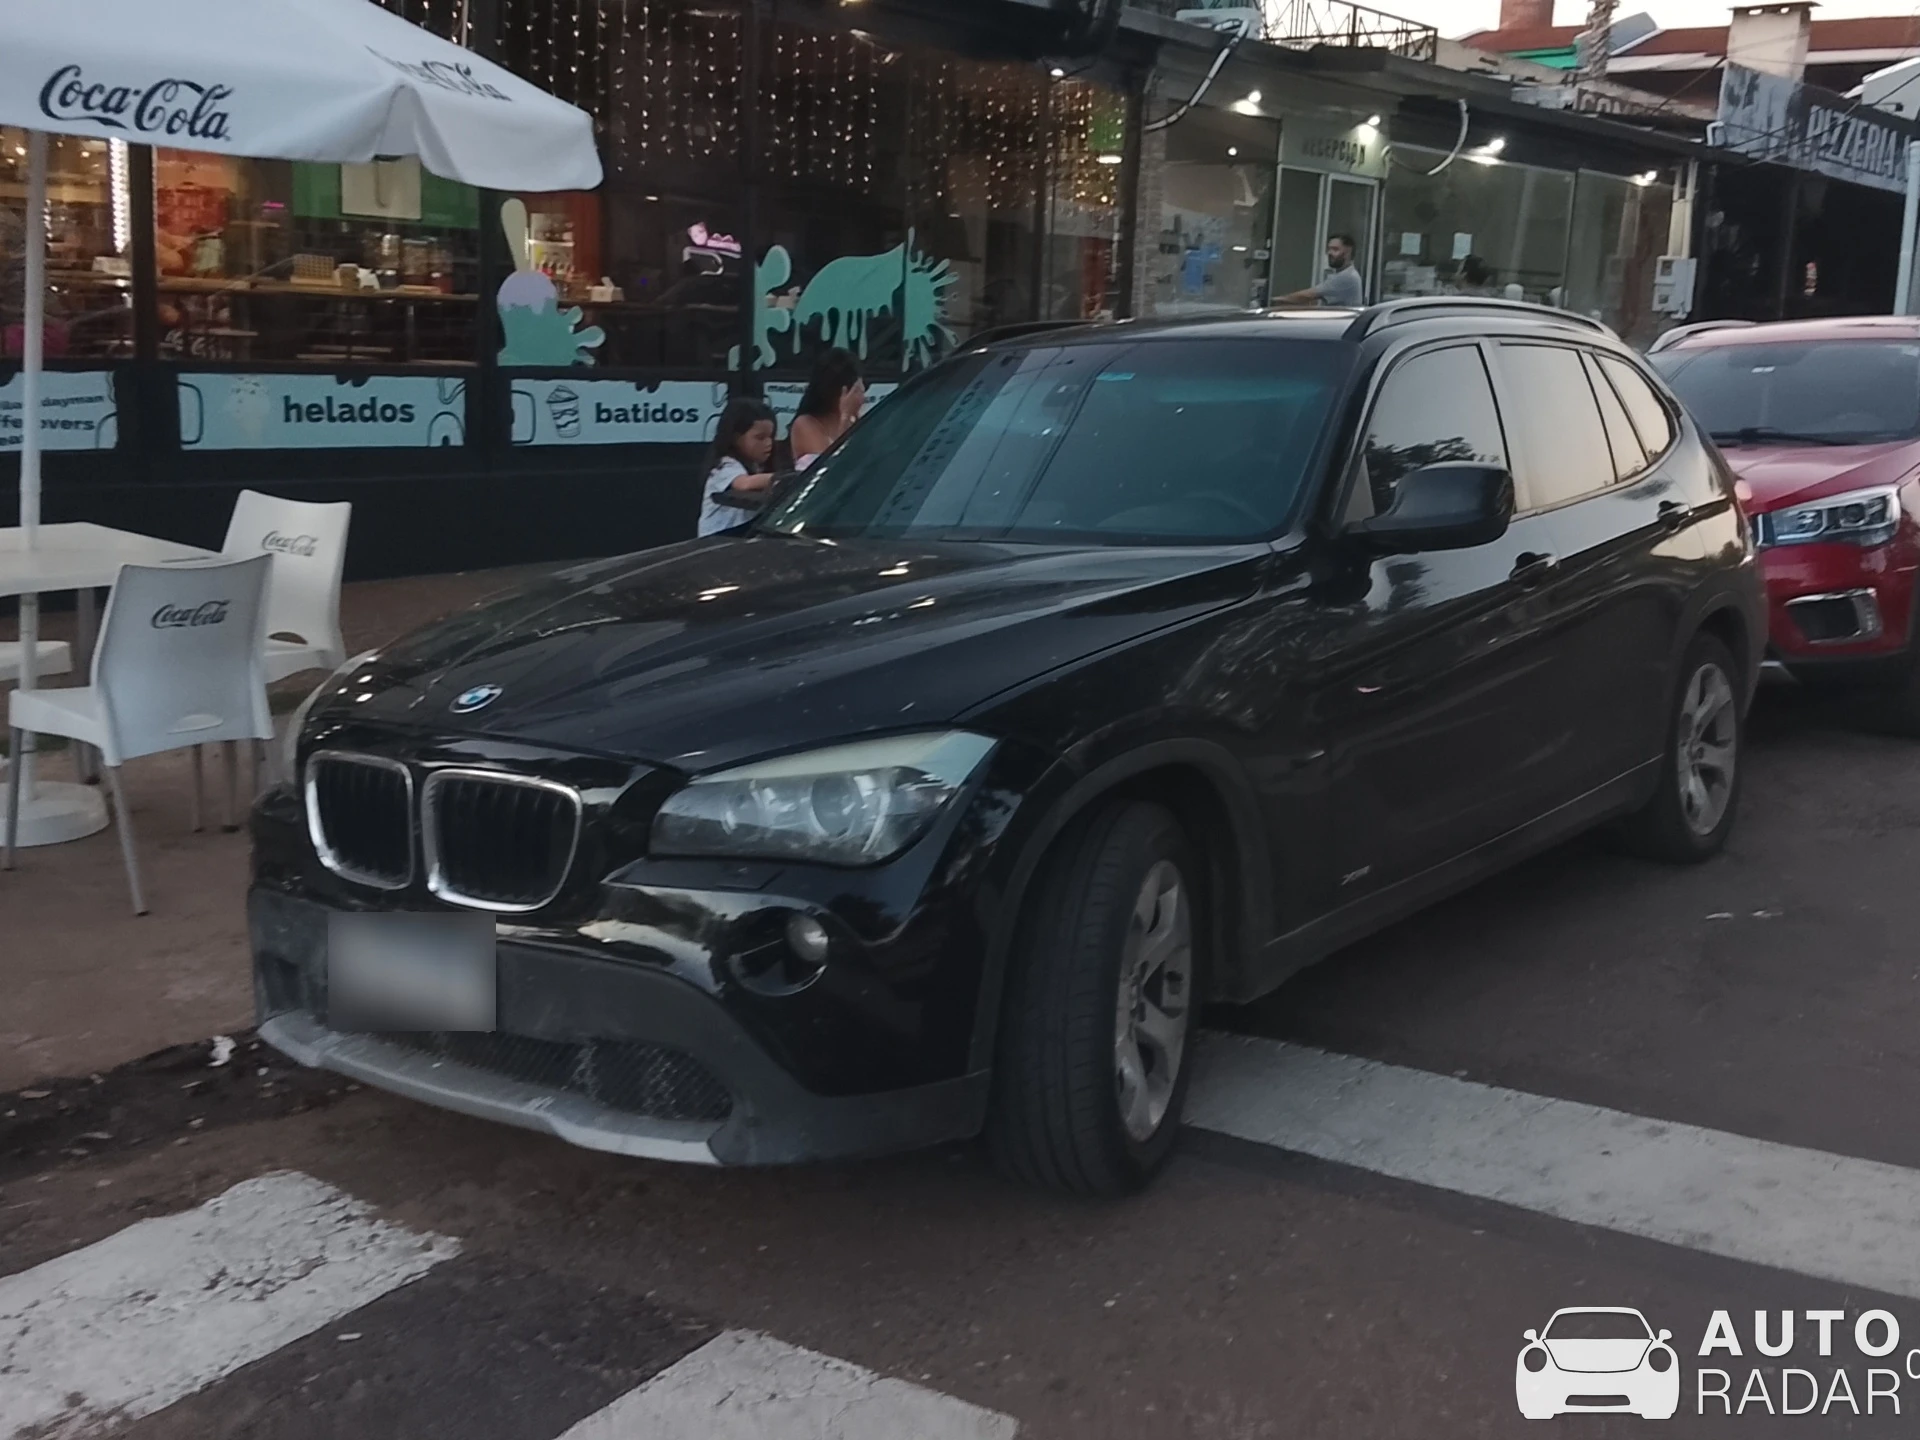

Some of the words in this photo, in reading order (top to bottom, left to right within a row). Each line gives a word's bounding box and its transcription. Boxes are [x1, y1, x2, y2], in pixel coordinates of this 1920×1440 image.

[39, 64, 233, 140] Coca-Cola
[1806, 104, 1897, 176] PIZZERIA
[283, 395, 415, 423] helados
[595, 402, 699, 424] batidos
[151, 599, 231, 629] Coca-Cola
